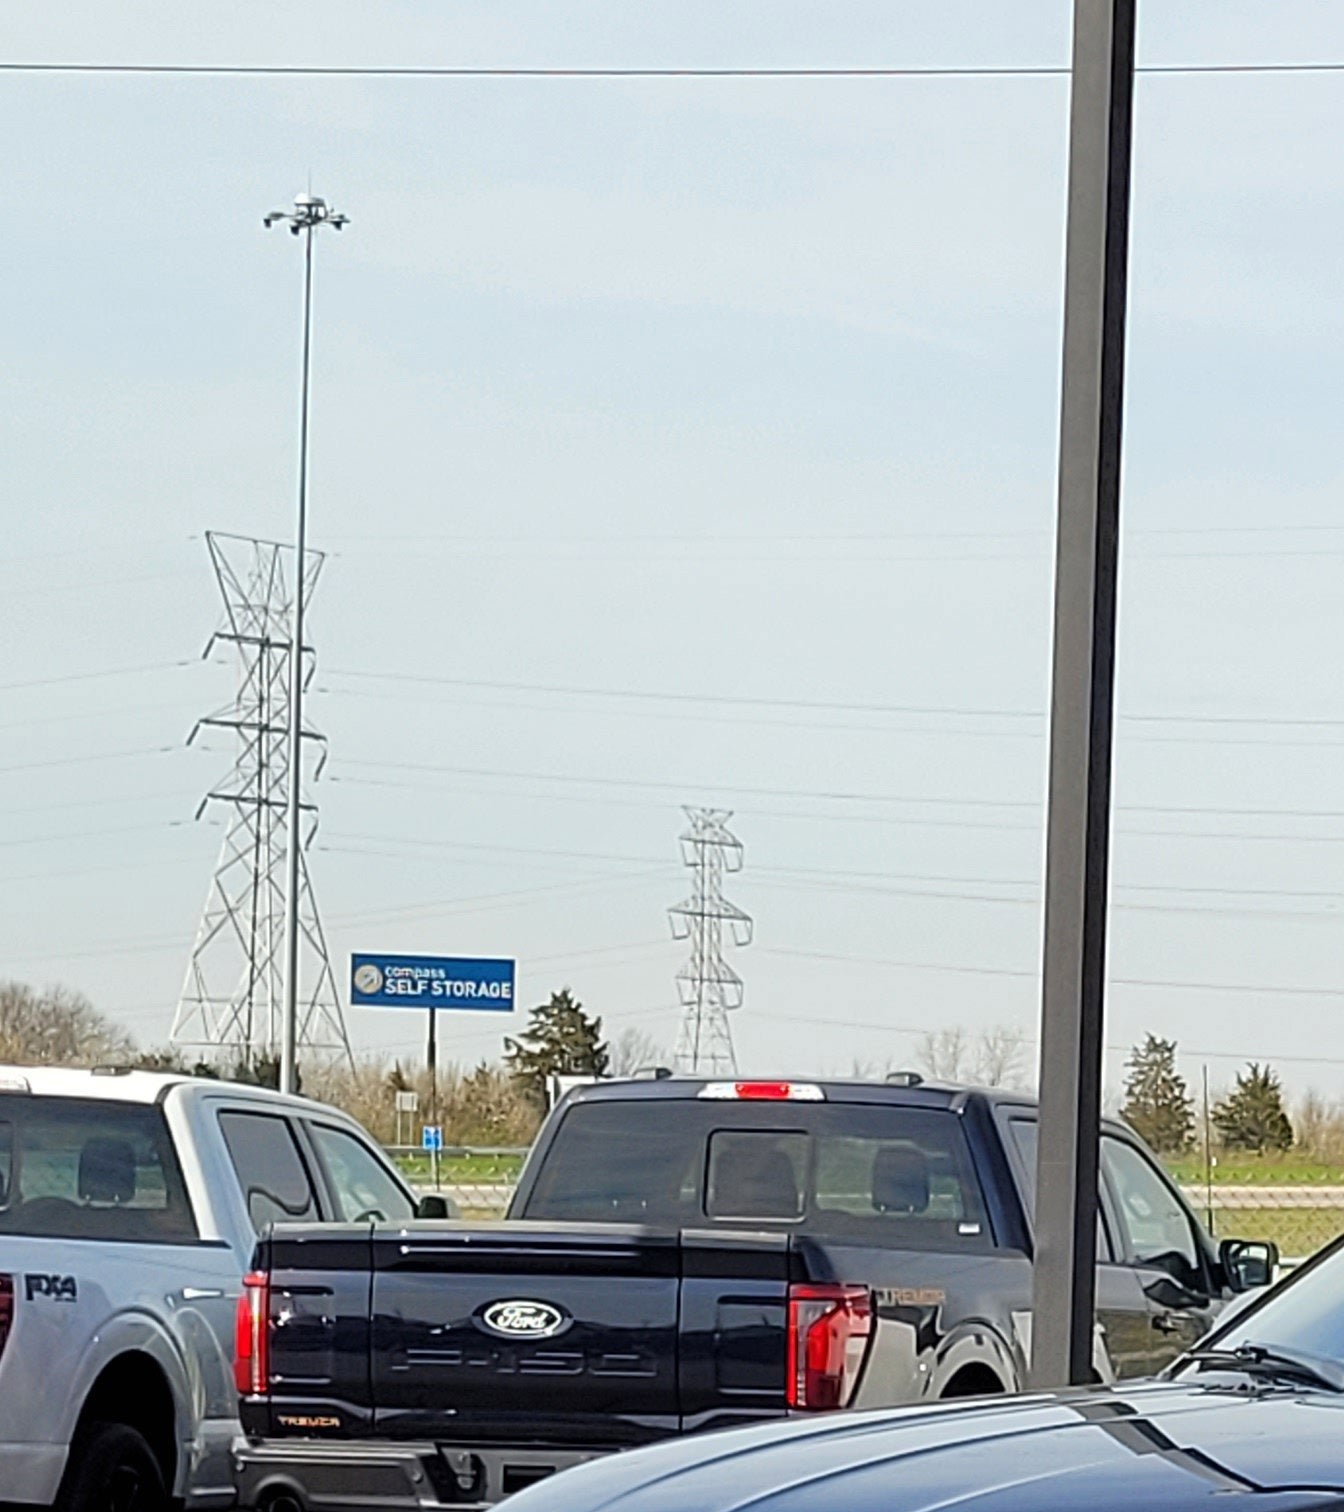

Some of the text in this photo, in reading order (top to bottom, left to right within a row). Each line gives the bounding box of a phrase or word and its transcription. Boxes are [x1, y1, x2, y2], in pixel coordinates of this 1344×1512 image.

[384, 966, 446, 980] compass
[384, 978, 513, 999] SELF STORAGE
[24, 1274, 77, 1301] FX4
